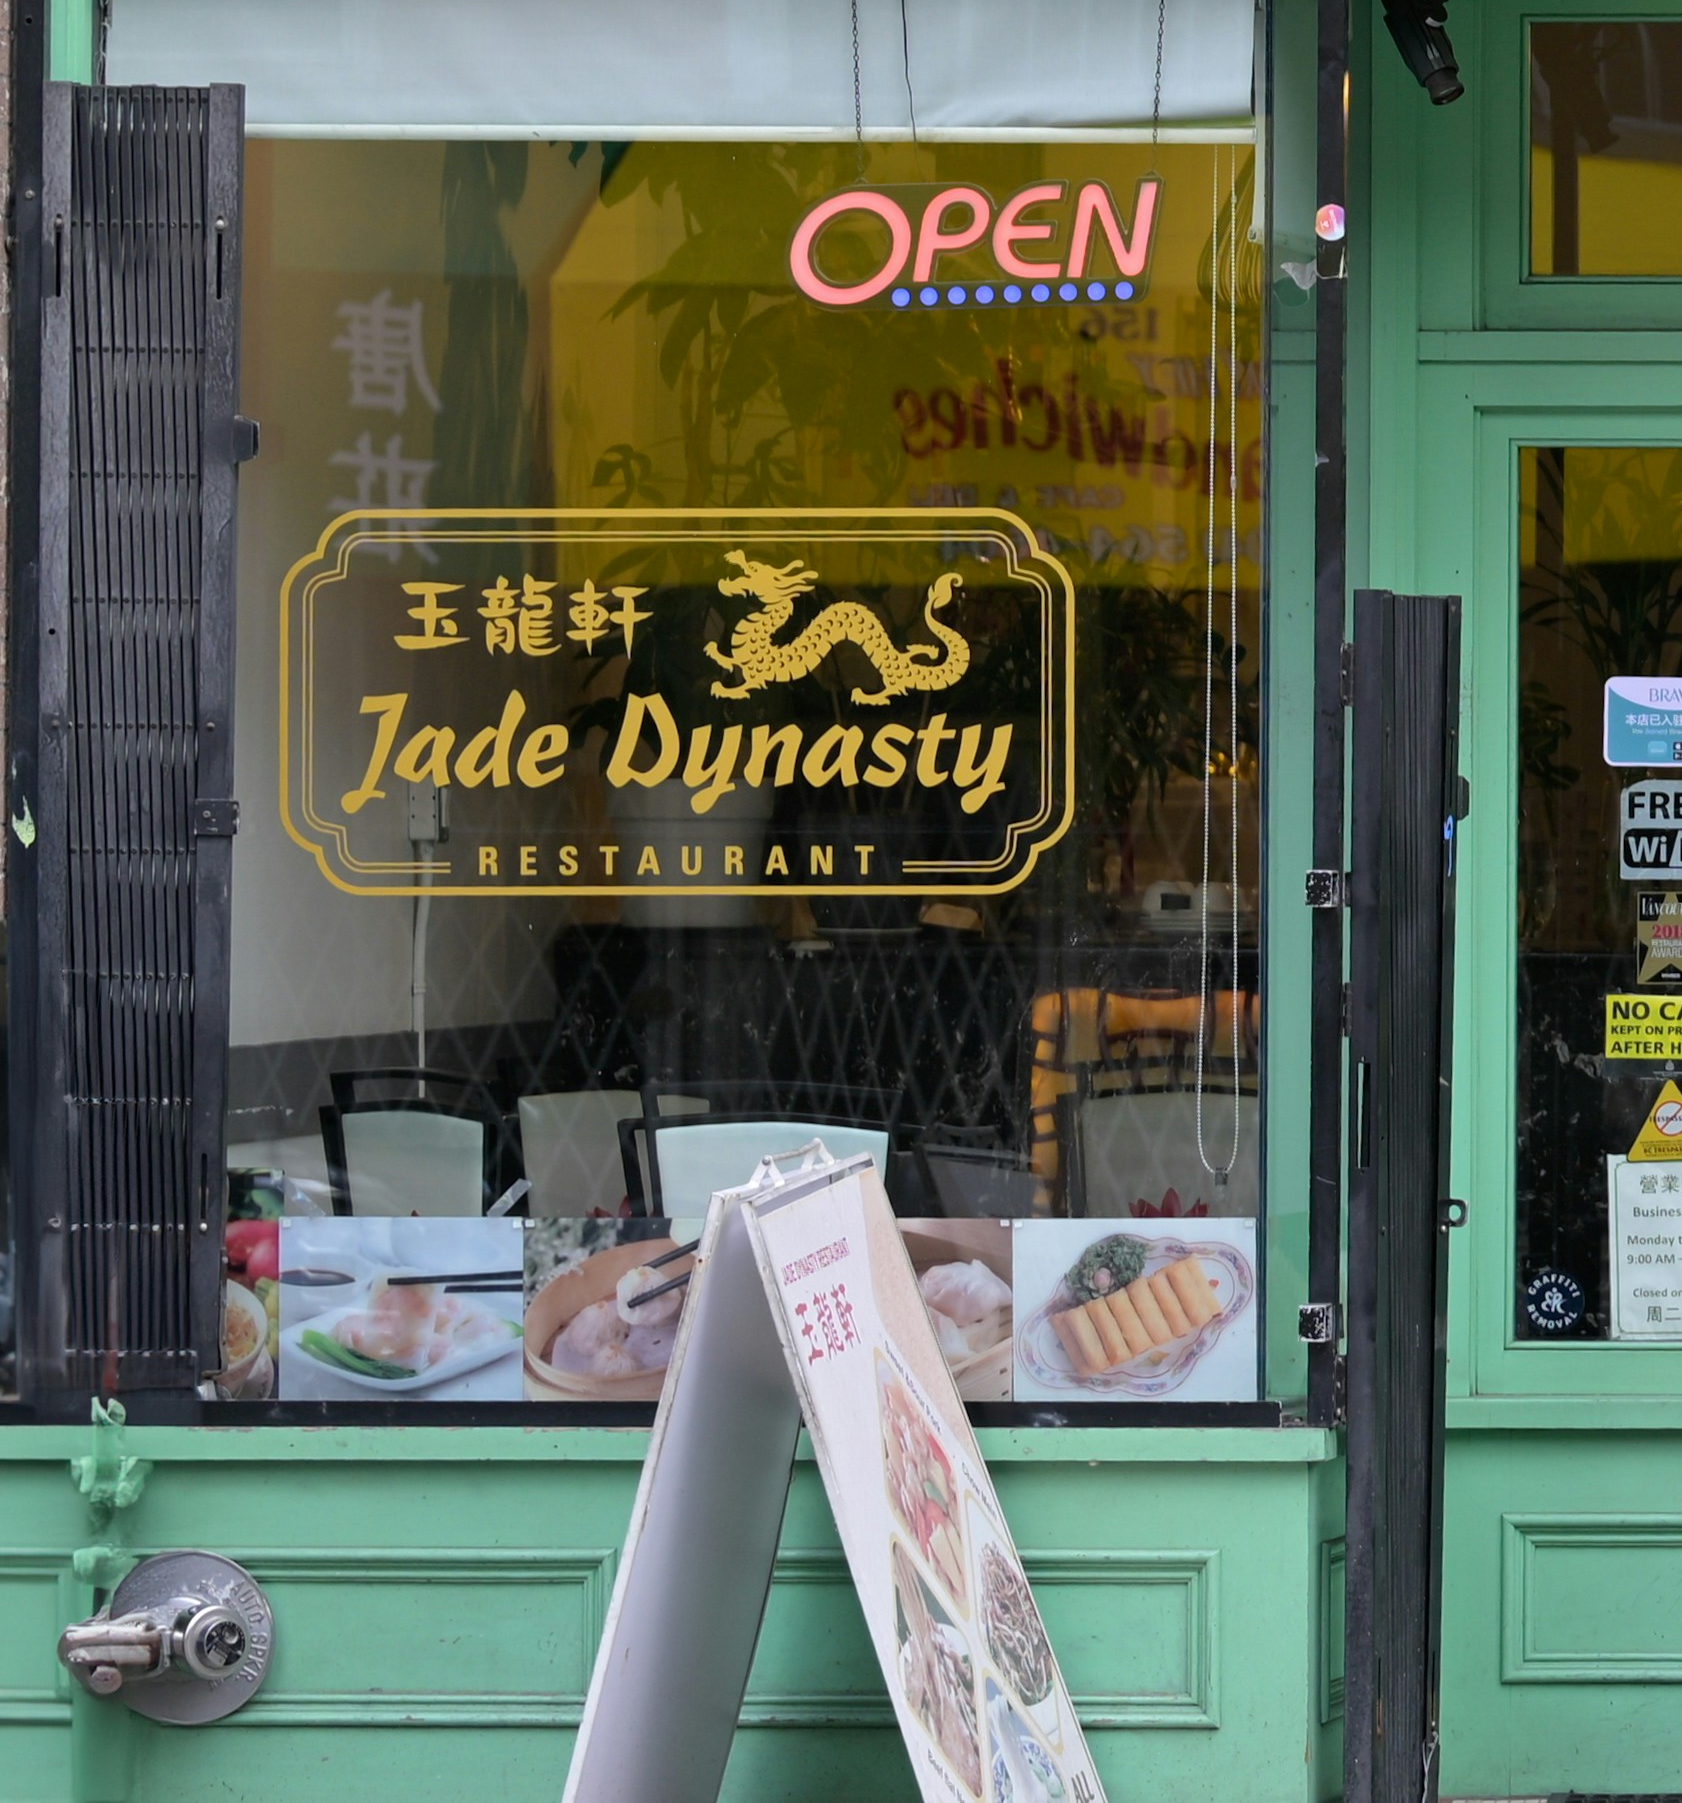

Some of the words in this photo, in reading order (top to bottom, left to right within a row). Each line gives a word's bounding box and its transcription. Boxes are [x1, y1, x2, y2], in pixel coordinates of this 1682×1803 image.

[788, 180, 1160, 306] OPEN
[392, 573, 655, 661] 玉龍軒
[340, 688, 570, 815] Jade
[605, 692, 1017, 815] Dynasty
[477, 843, 876, 877] RESTAURANT
[1611, 1001, 1651, 1021] NO
[1611, 1025, 1642, 1036] KEPT
[1645, 1025, 1664, 1036] ON
[1610, 1041, 1664, 1055] AFTER
[1627, 1233, 1675, 1248] Monday
[1626, 1253, 1653, 1265] 9:00
[1655, 1253, 1676, 1264] AM
[1527, 1273, 1582, 1298] GRAFFITI
[1632, 1285, 1668, 1299] Closed
[794, 1283, 862, 1367] 玉龍軒
[1526, 1303, 1579, 1330] REMOVAL
[1071, 1769, 1096, 1803] ALL
